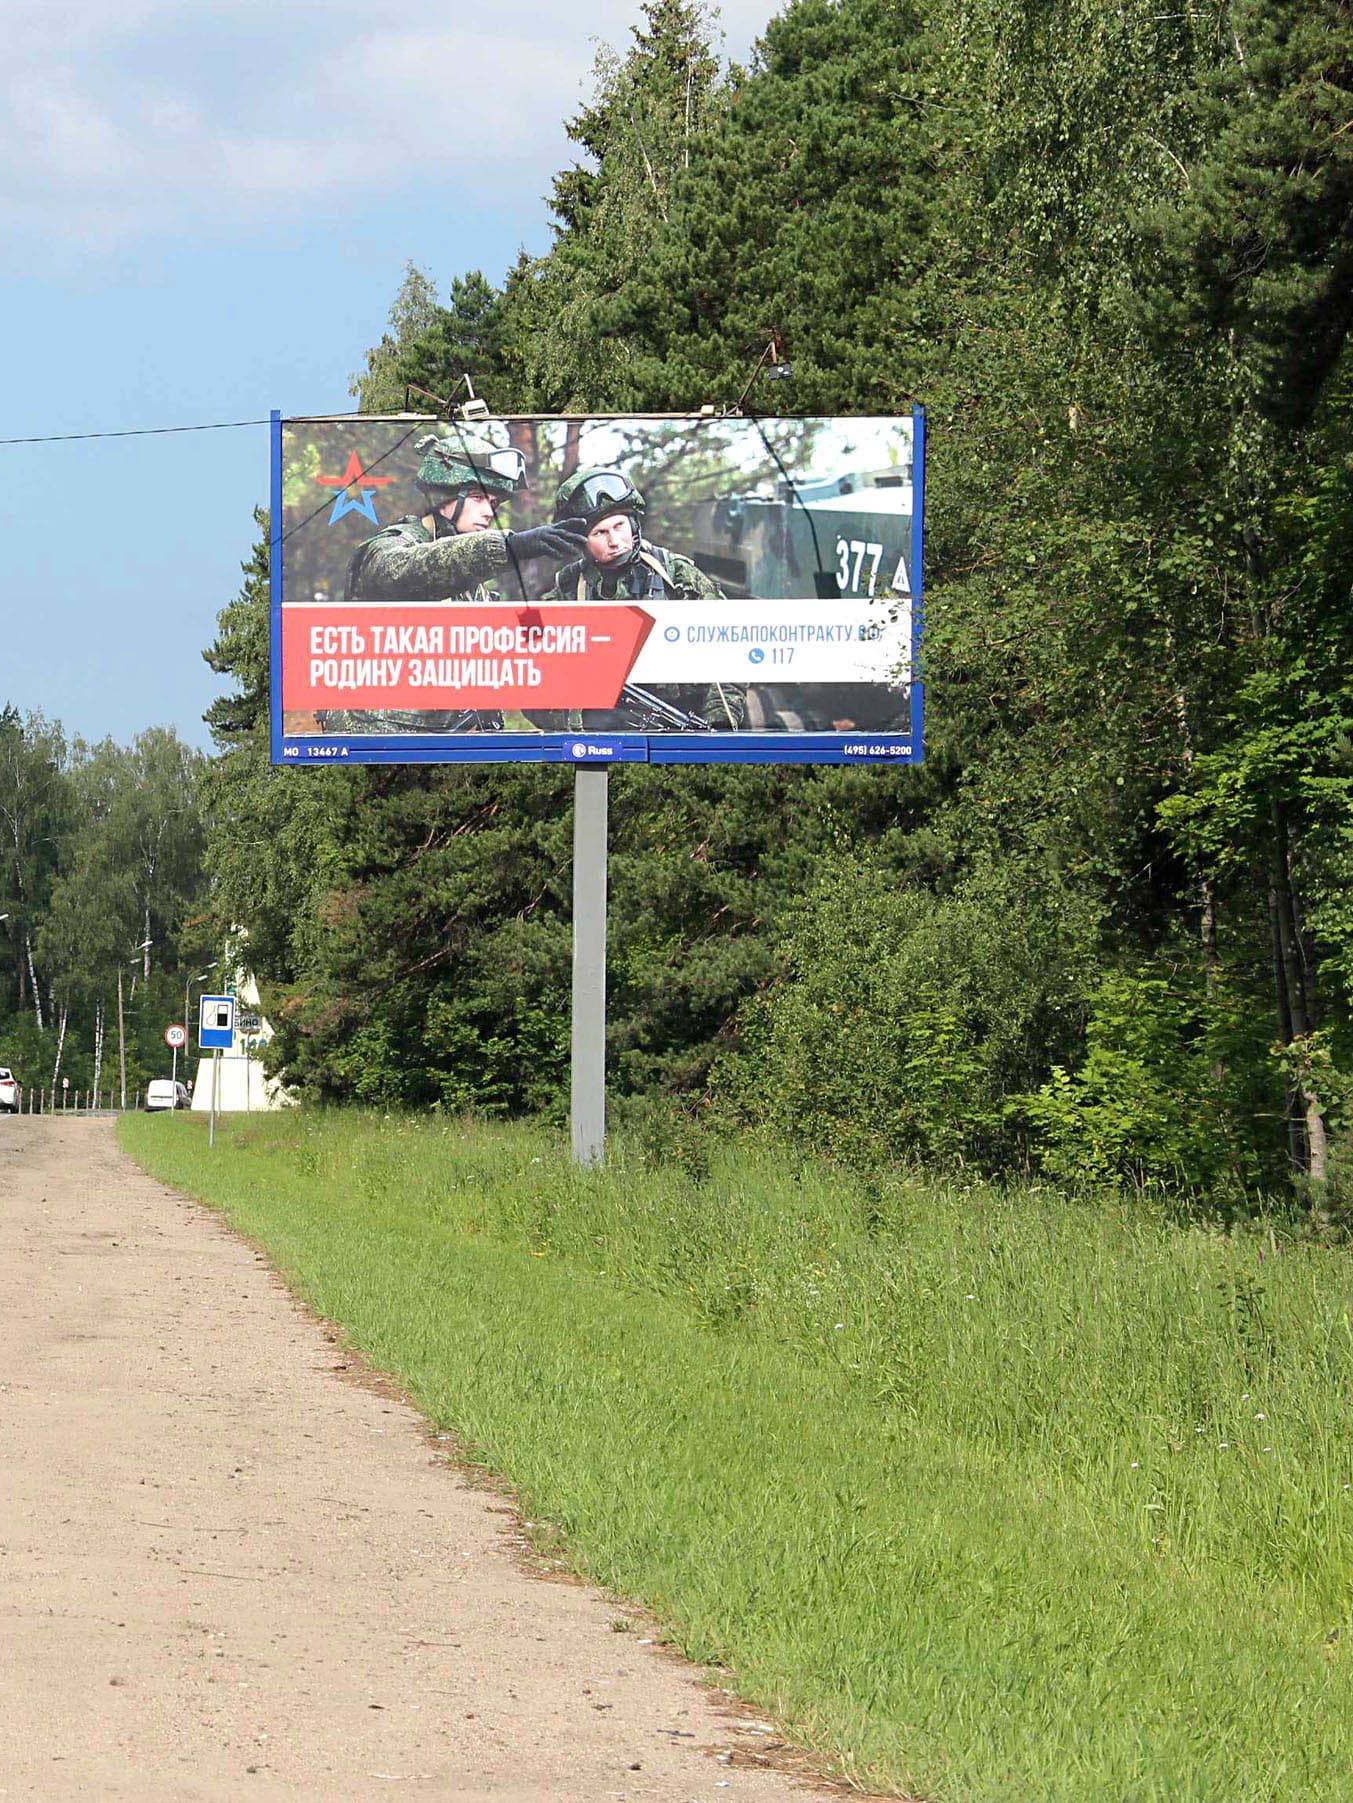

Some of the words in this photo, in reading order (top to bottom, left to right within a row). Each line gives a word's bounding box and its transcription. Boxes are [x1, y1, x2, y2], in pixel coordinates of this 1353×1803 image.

[835, 539, 883, 597] 377
[310, 626, 365, 655] ЕСТЬ
[371, 626, 444, 655] ТАКАЯ
[449, 625, 586, 654] ПРОФЕССИЯ
[772, 648, 794, 664] 117
[310, 659, 403, 690] РОДИНУ
[408, 659, 542, 690] ЗАЩИЩАТЬ
[308, 747, 338, 756] 13467
[588, 746, 613, 756] Russ
[844, 746, 868, 756] (495)
[869, 746, 912, 756] 626-5200
[170, 1030, 183, 1039] 50
